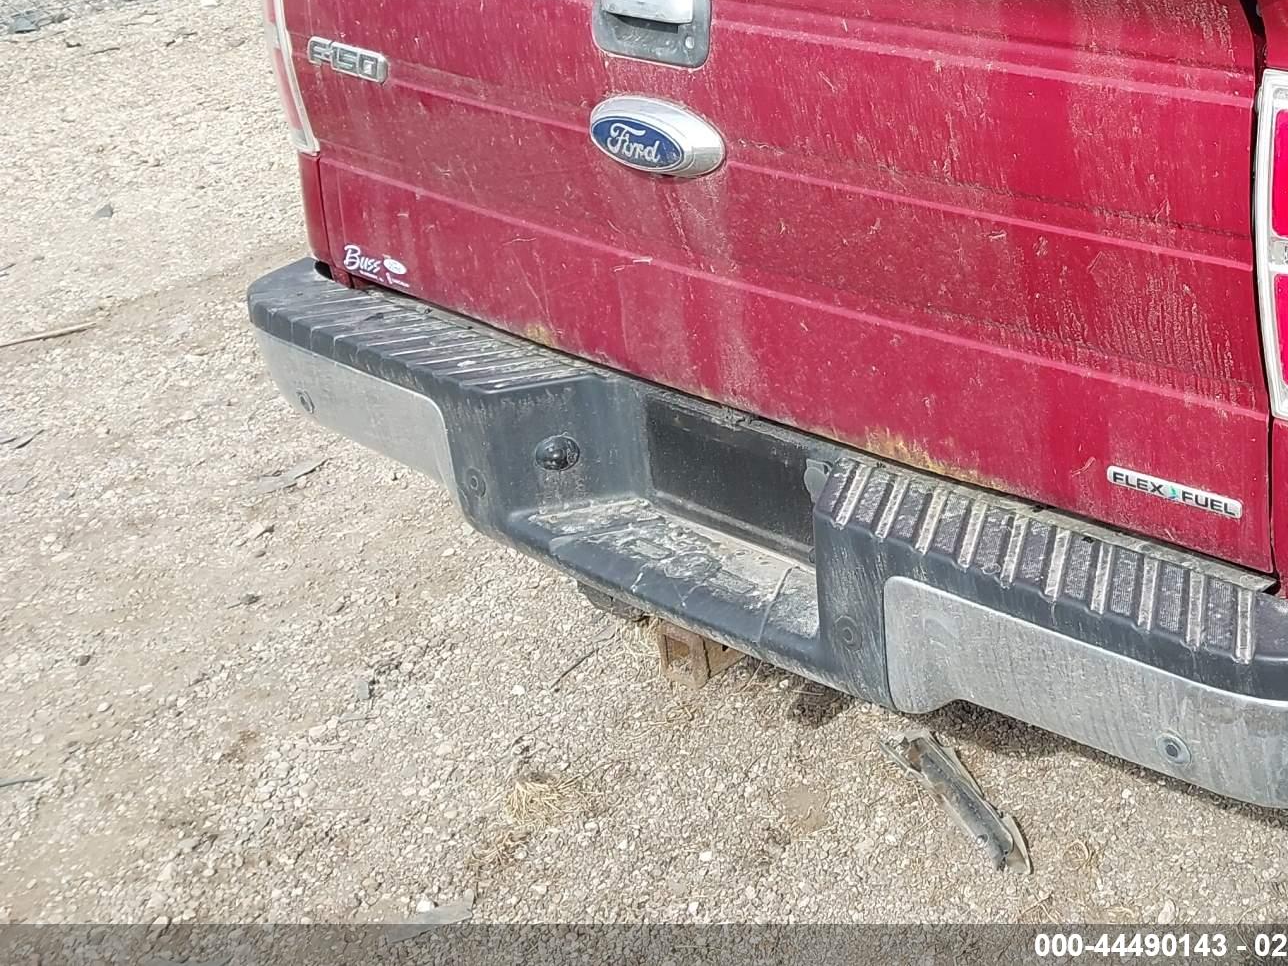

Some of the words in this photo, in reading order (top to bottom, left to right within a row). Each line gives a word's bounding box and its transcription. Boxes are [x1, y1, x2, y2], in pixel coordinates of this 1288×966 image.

[607, 122, 660, 162] Ford
[343, 244, 382, 273] Buss
[1112, 471, 1165, 496] FLEX
[1181, 490, 1236, 516] FUEL
